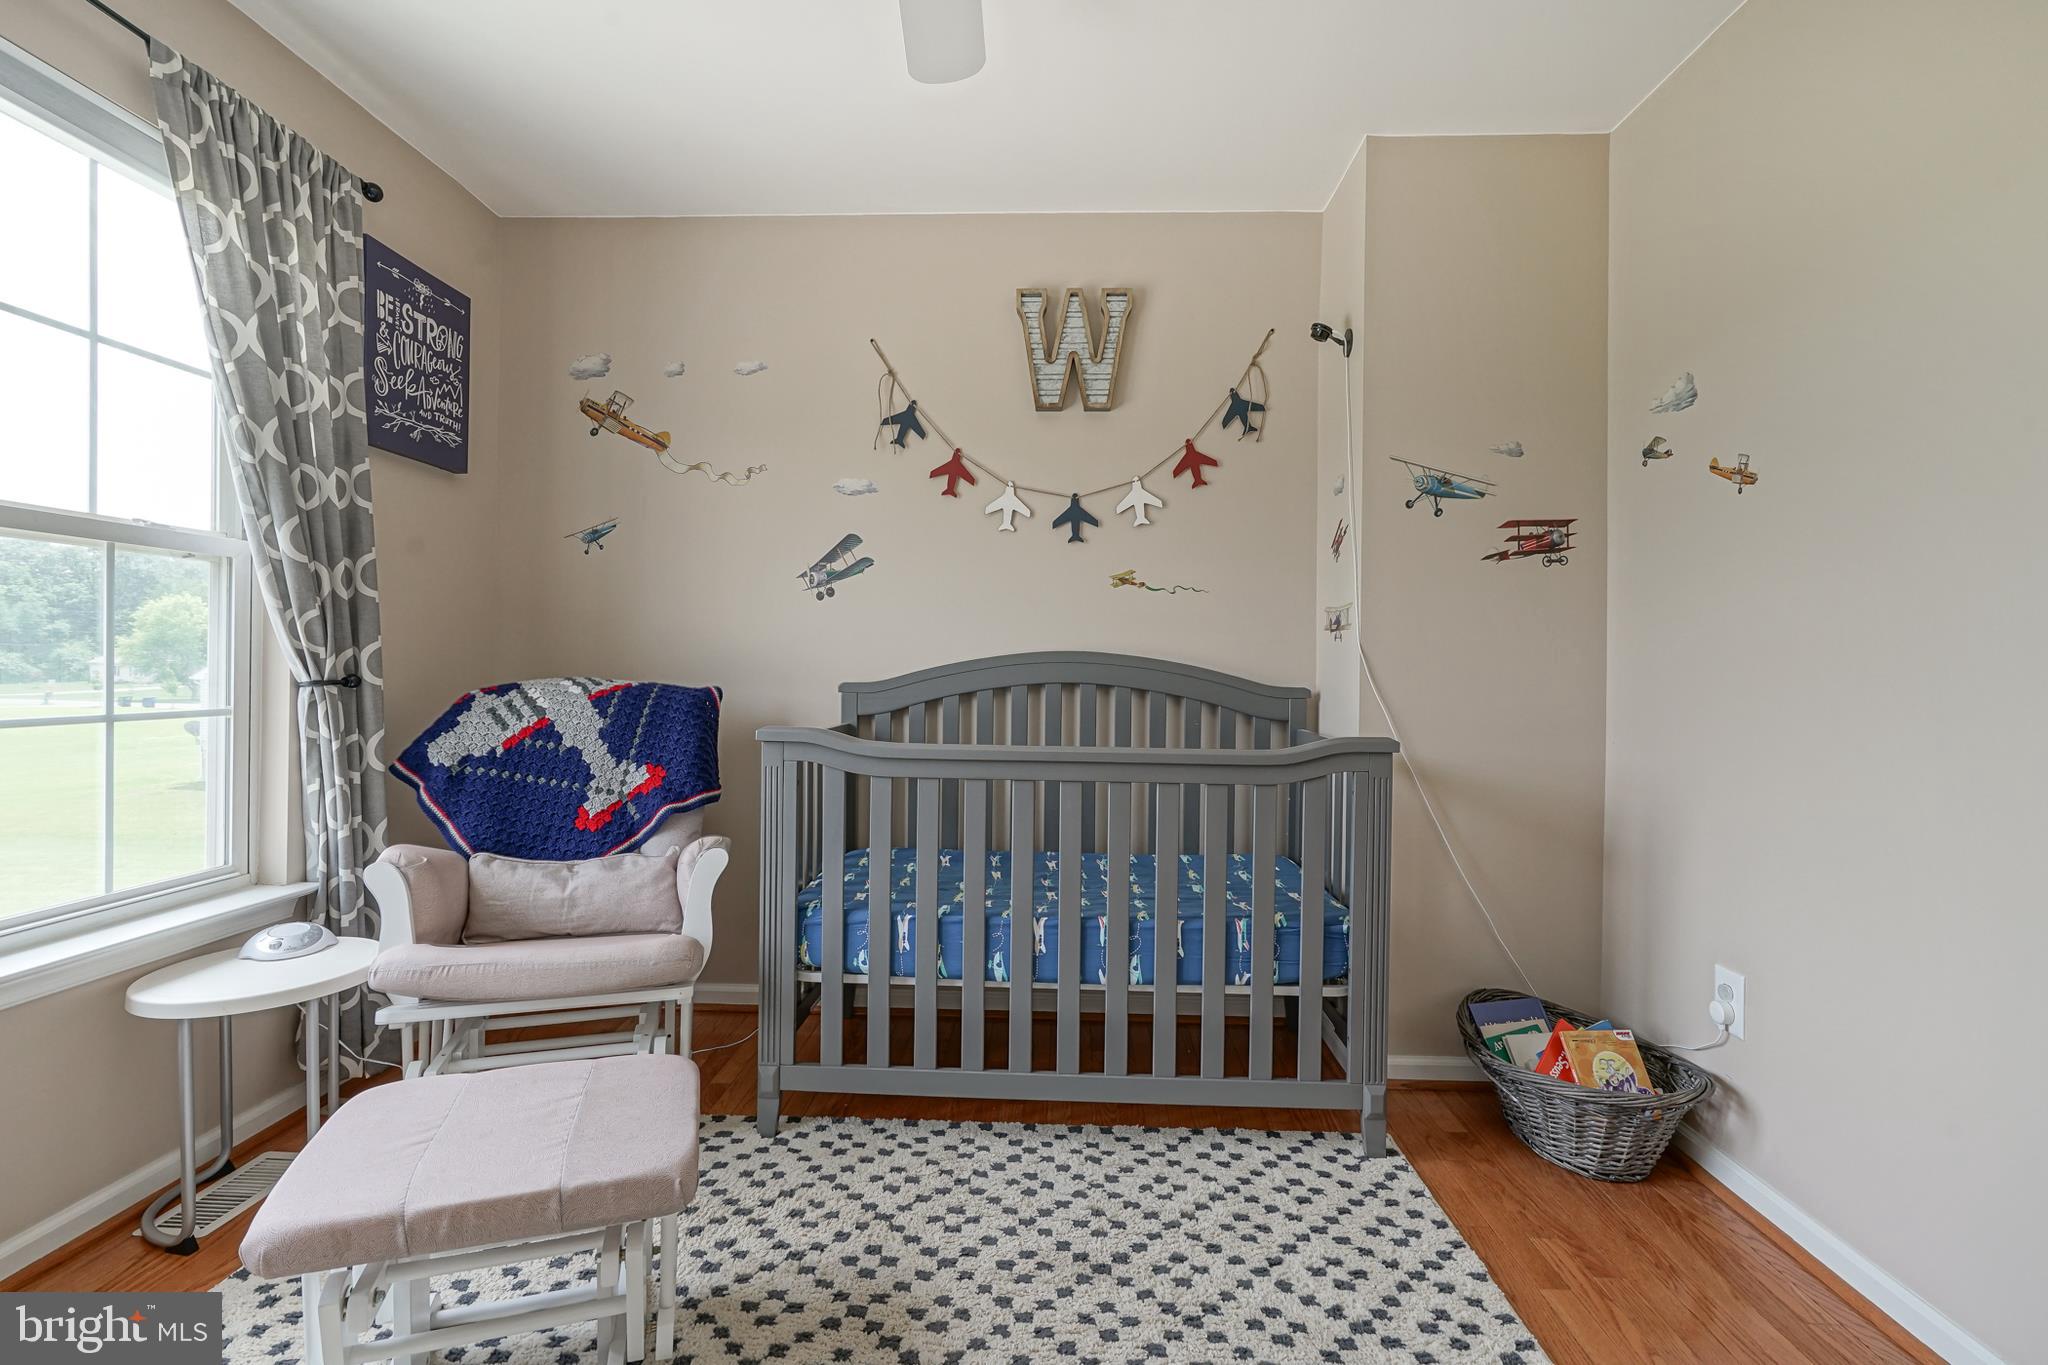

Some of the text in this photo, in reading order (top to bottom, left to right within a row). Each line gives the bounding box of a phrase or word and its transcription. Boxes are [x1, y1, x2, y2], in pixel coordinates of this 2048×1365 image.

[377, 289, 393, 323] BE
[402, 303, 464, 359] STRONG
[380, 321, 390, 340] &
[1016, 288, 1133, 411] W
[419, 409, 461, 433] AND TRUTH!
